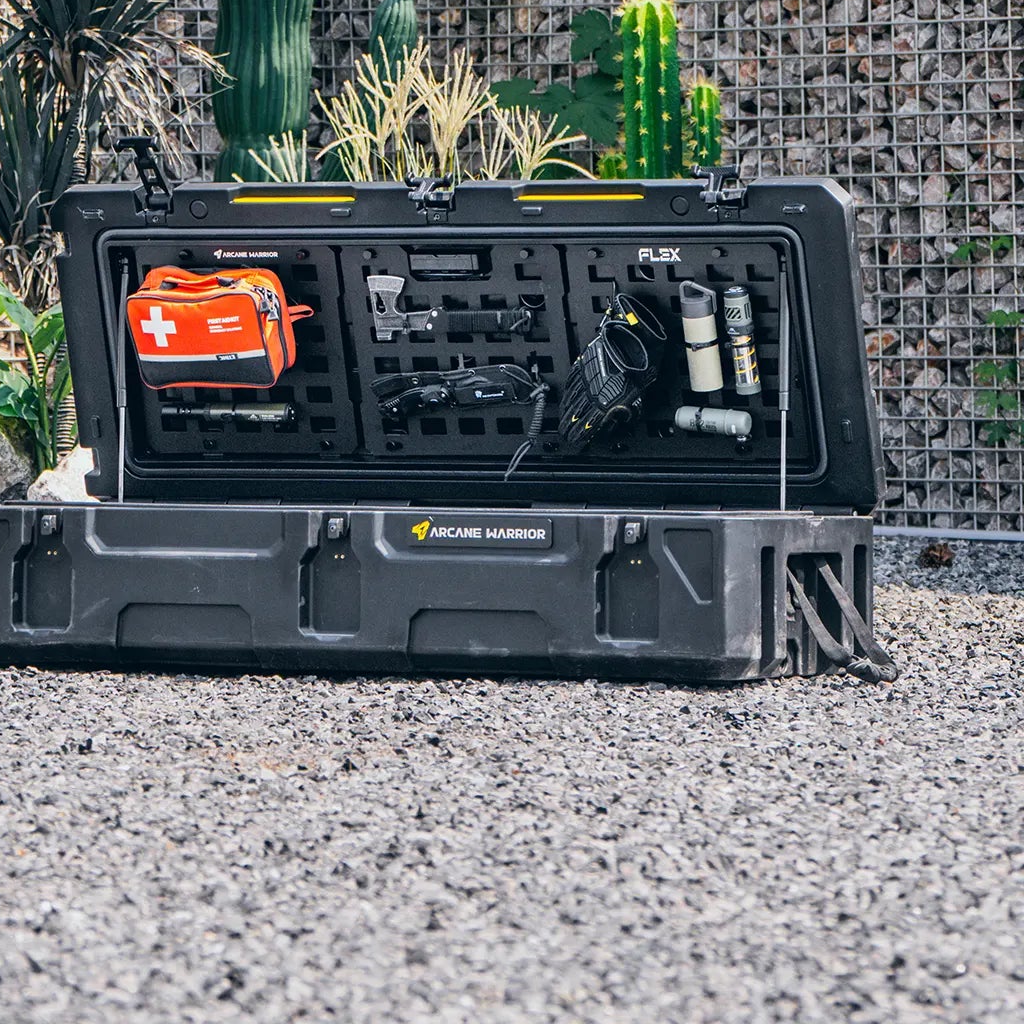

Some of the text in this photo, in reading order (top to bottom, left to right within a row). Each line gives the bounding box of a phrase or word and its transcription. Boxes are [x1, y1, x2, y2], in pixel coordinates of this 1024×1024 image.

[638, 247, 682, 262] FLEX
[429, 527, 546, 540] ARCANE WARRIOR
